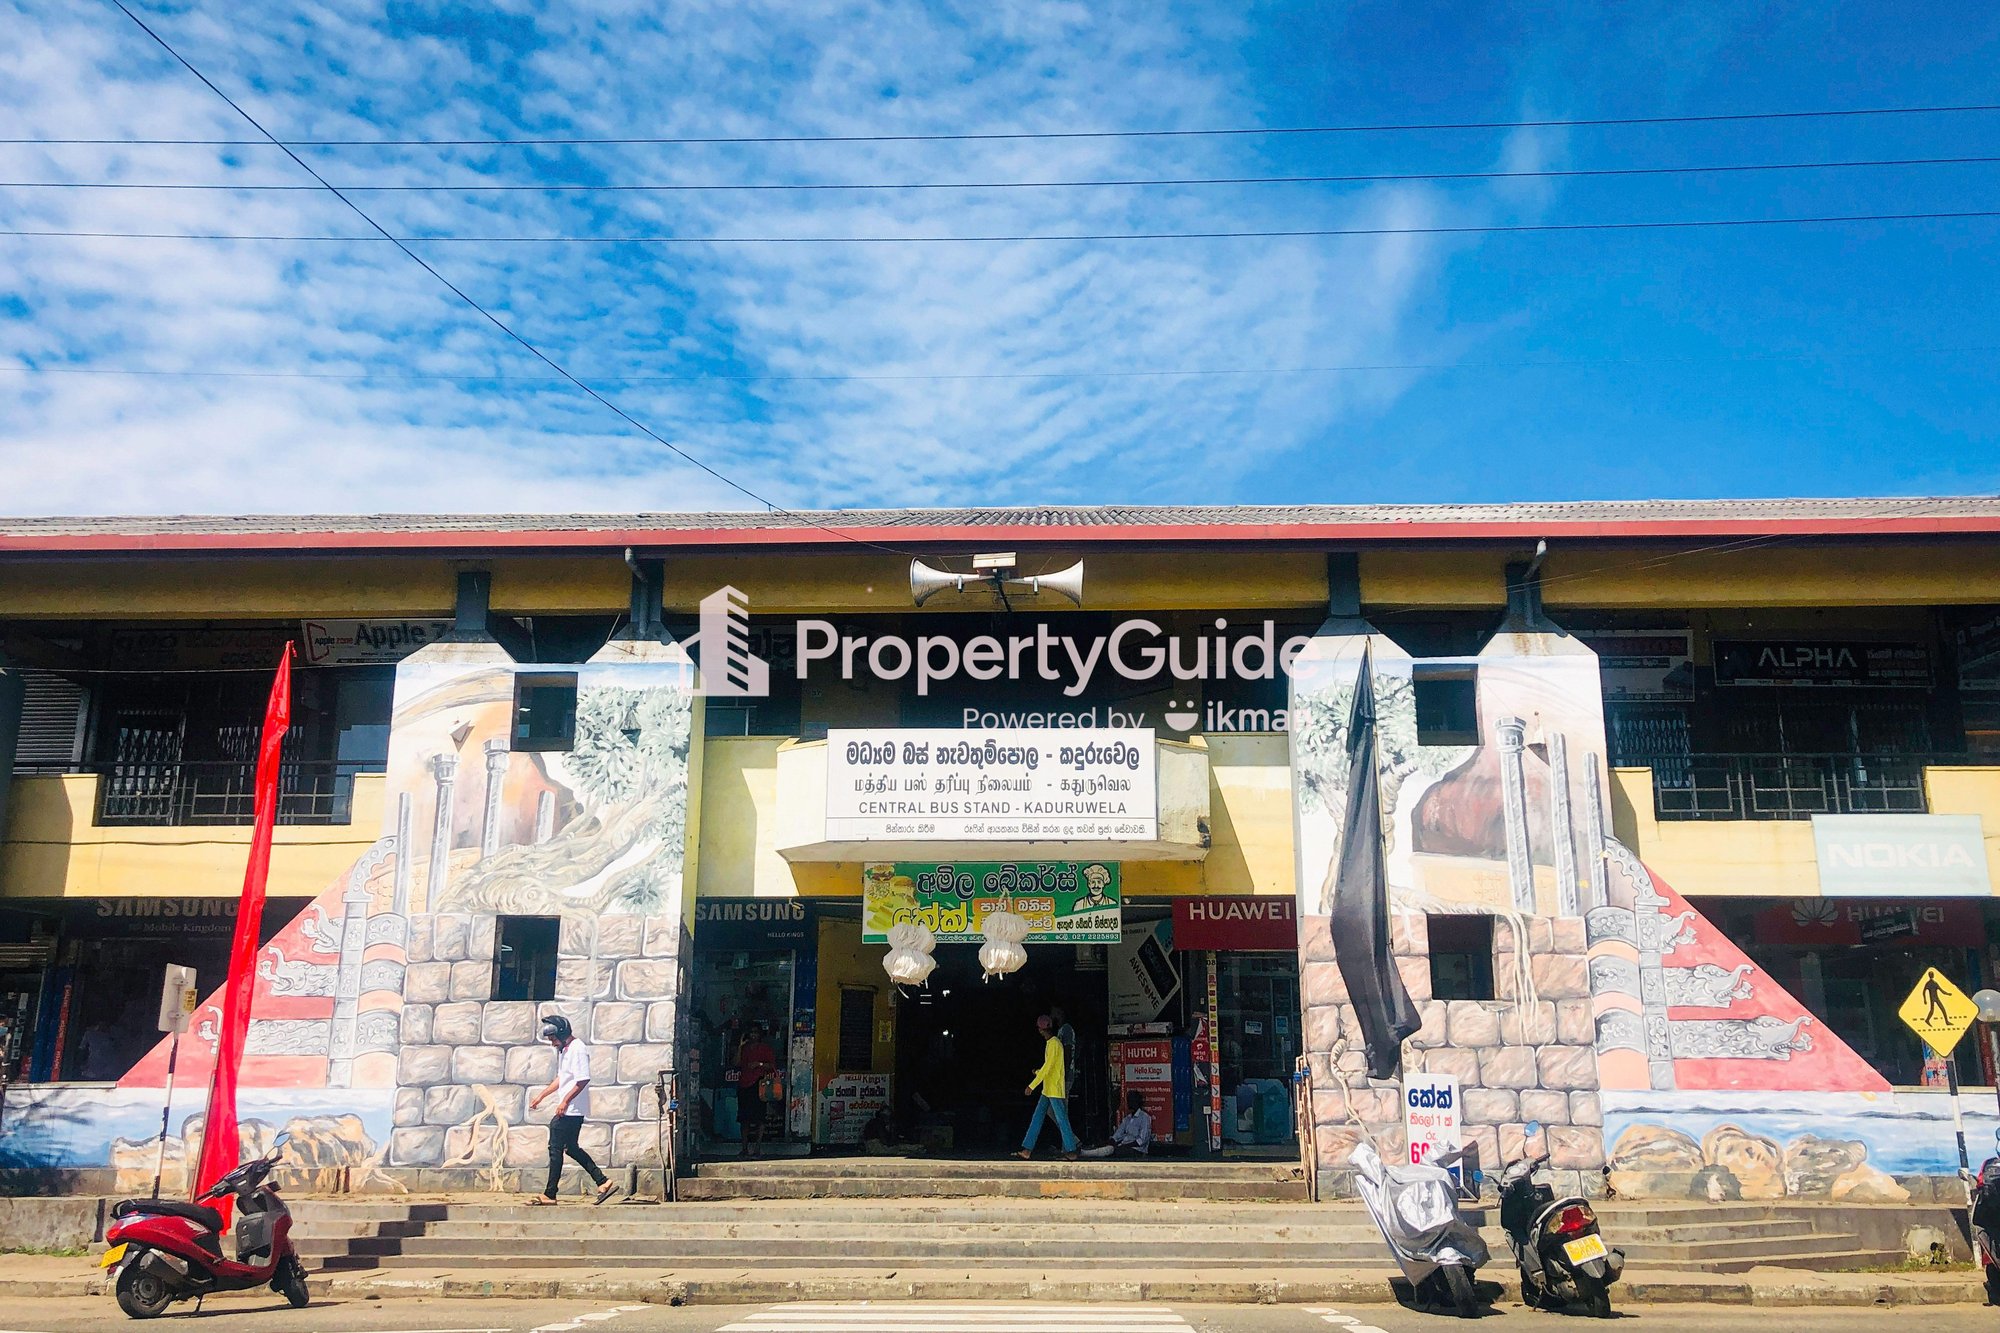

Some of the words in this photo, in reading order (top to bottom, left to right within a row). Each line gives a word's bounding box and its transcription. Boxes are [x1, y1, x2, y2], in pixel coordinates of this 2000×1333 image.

[354, 622, 426, 649] Apple
[1758, 647, 1858, 668] ALPHA
[903, 741, 929, 765] බස්
[1060, 741, 1139, 770] කදුරුවෙල
[855, 772, 897, 795] மத்திய
[904, 772, 927, 791] பஸ்
[934, 772, 969, 795] தரிப்பு
[976, 772, 1032, 795] நிலையம்
[859, 802, 926, 814] CENTRAL
[930, 802, 959, 814] BUS
[964, 802, 1010, 814] STAND
[1024, 802, 1127, 814] KADURUWELA
[1827, 843, 1976, 868] NOKIA
[696, 903, 805, 921] SAMSUNG
[1189, 902, 1291, 920] HUAWEI
[183, 923, 232, 934] Kingdom
[1127, 1047, 1157, 1058] HUTCH
[1134, 1066, 1148, 1074] Hello
[1148, 1066, 1162, 1075] Kings
[1408, 1084, 1452, 1109] කේක්
